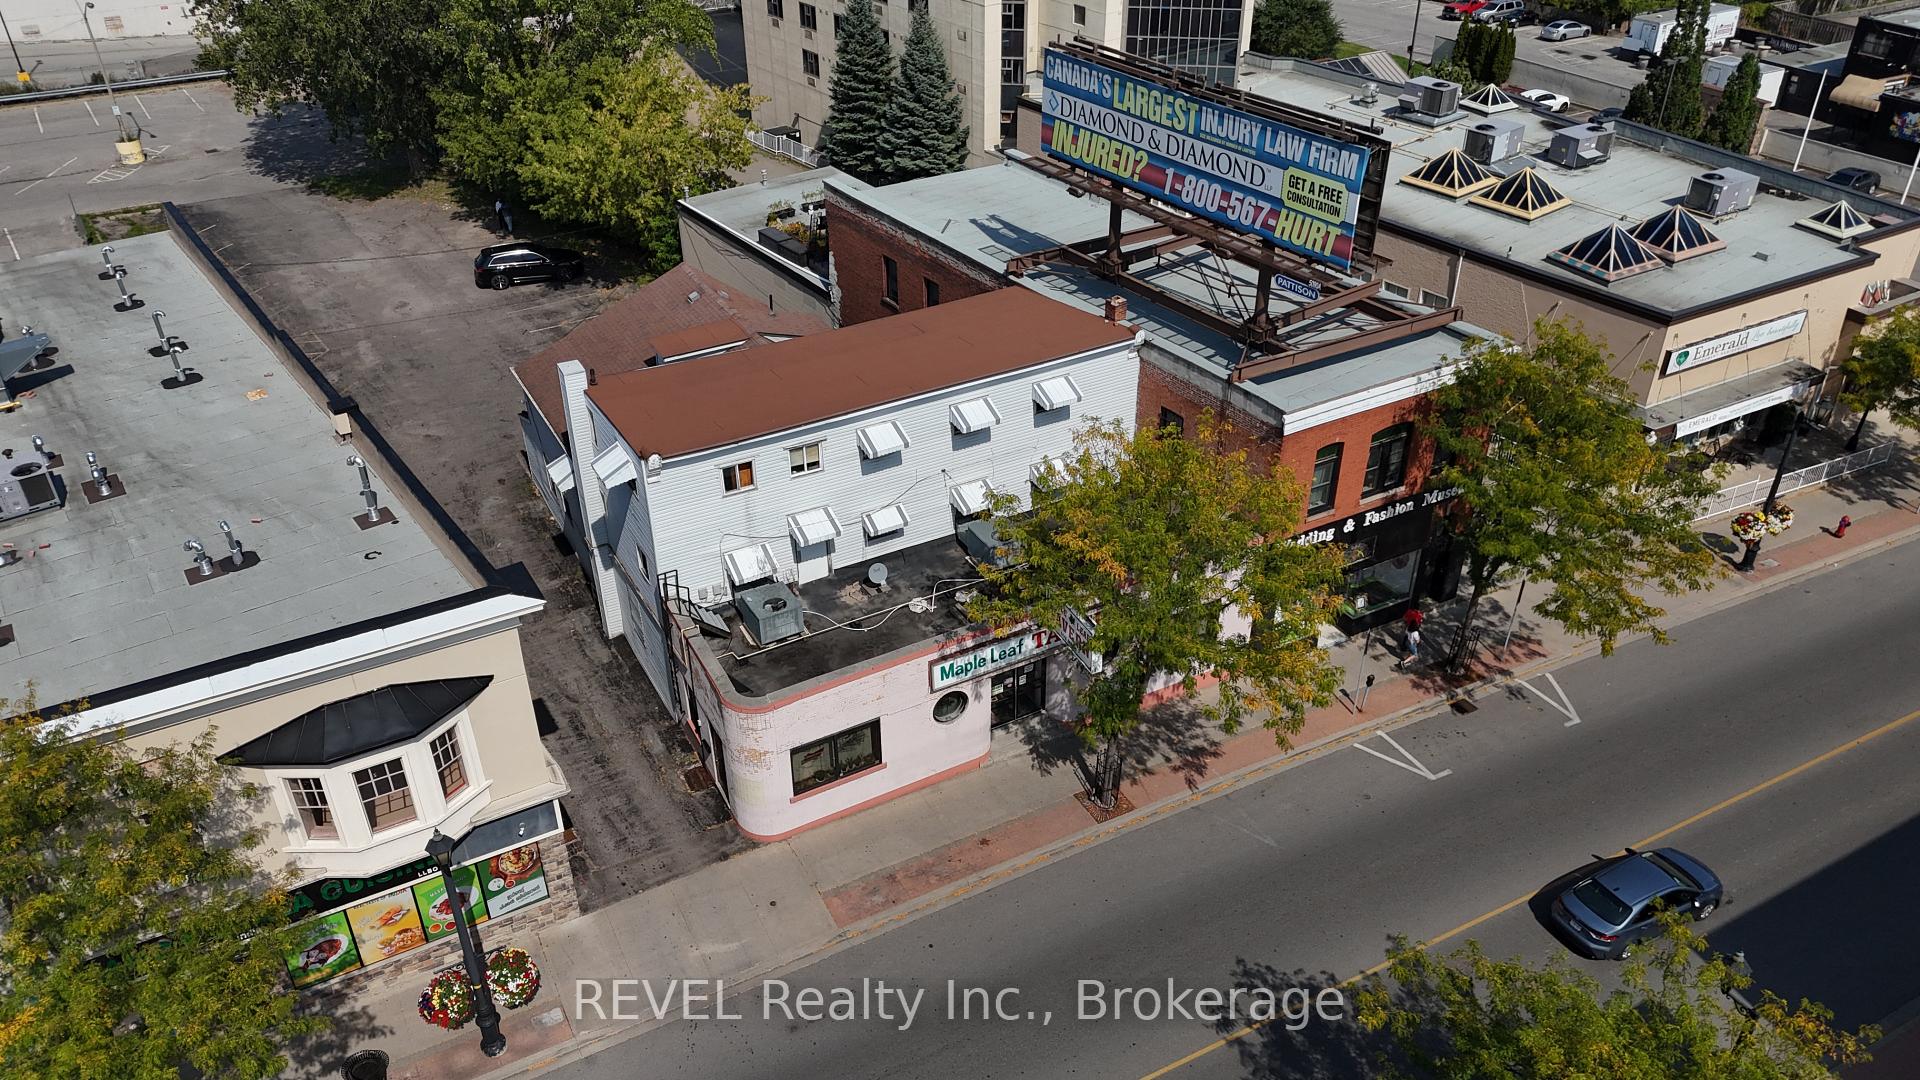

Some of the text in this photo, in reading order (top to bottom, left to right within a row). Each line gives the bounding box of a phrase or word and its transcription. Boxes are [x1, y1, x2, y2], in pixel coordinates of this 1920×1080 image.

[1046, 55, 1112, 99] CANADA'S
[1113, 77, 1199, 135] LARGEST
[1200, 105, 1262, 149] INJURY
[1264, 126, 1307, 163] LAW
[1308, 141, 1360, 181] FIRM
[1060, 96, 1145, 144] DIAMOND
[1148, 128, 1162, 152] &
[1166, 133, 1266, 187] DIAMOND
[1051, 119, 1149, 183] INJURED?
[1164, 167, 1342, 257] 1-800-567-HURT
[1287, 190, 1341, 218] CONSULTATION
[1289, 174, 1344, 205] GET A FREE
[1277, 277, 1316, 299] PATTISON
[1693, 332, 1750, 360] Emerald
[1285, 486, 1465, 547] dding & Fashion Museu
[940, 655, 987, 681] Maple
[990, 638, 1024, 664] Leaf
